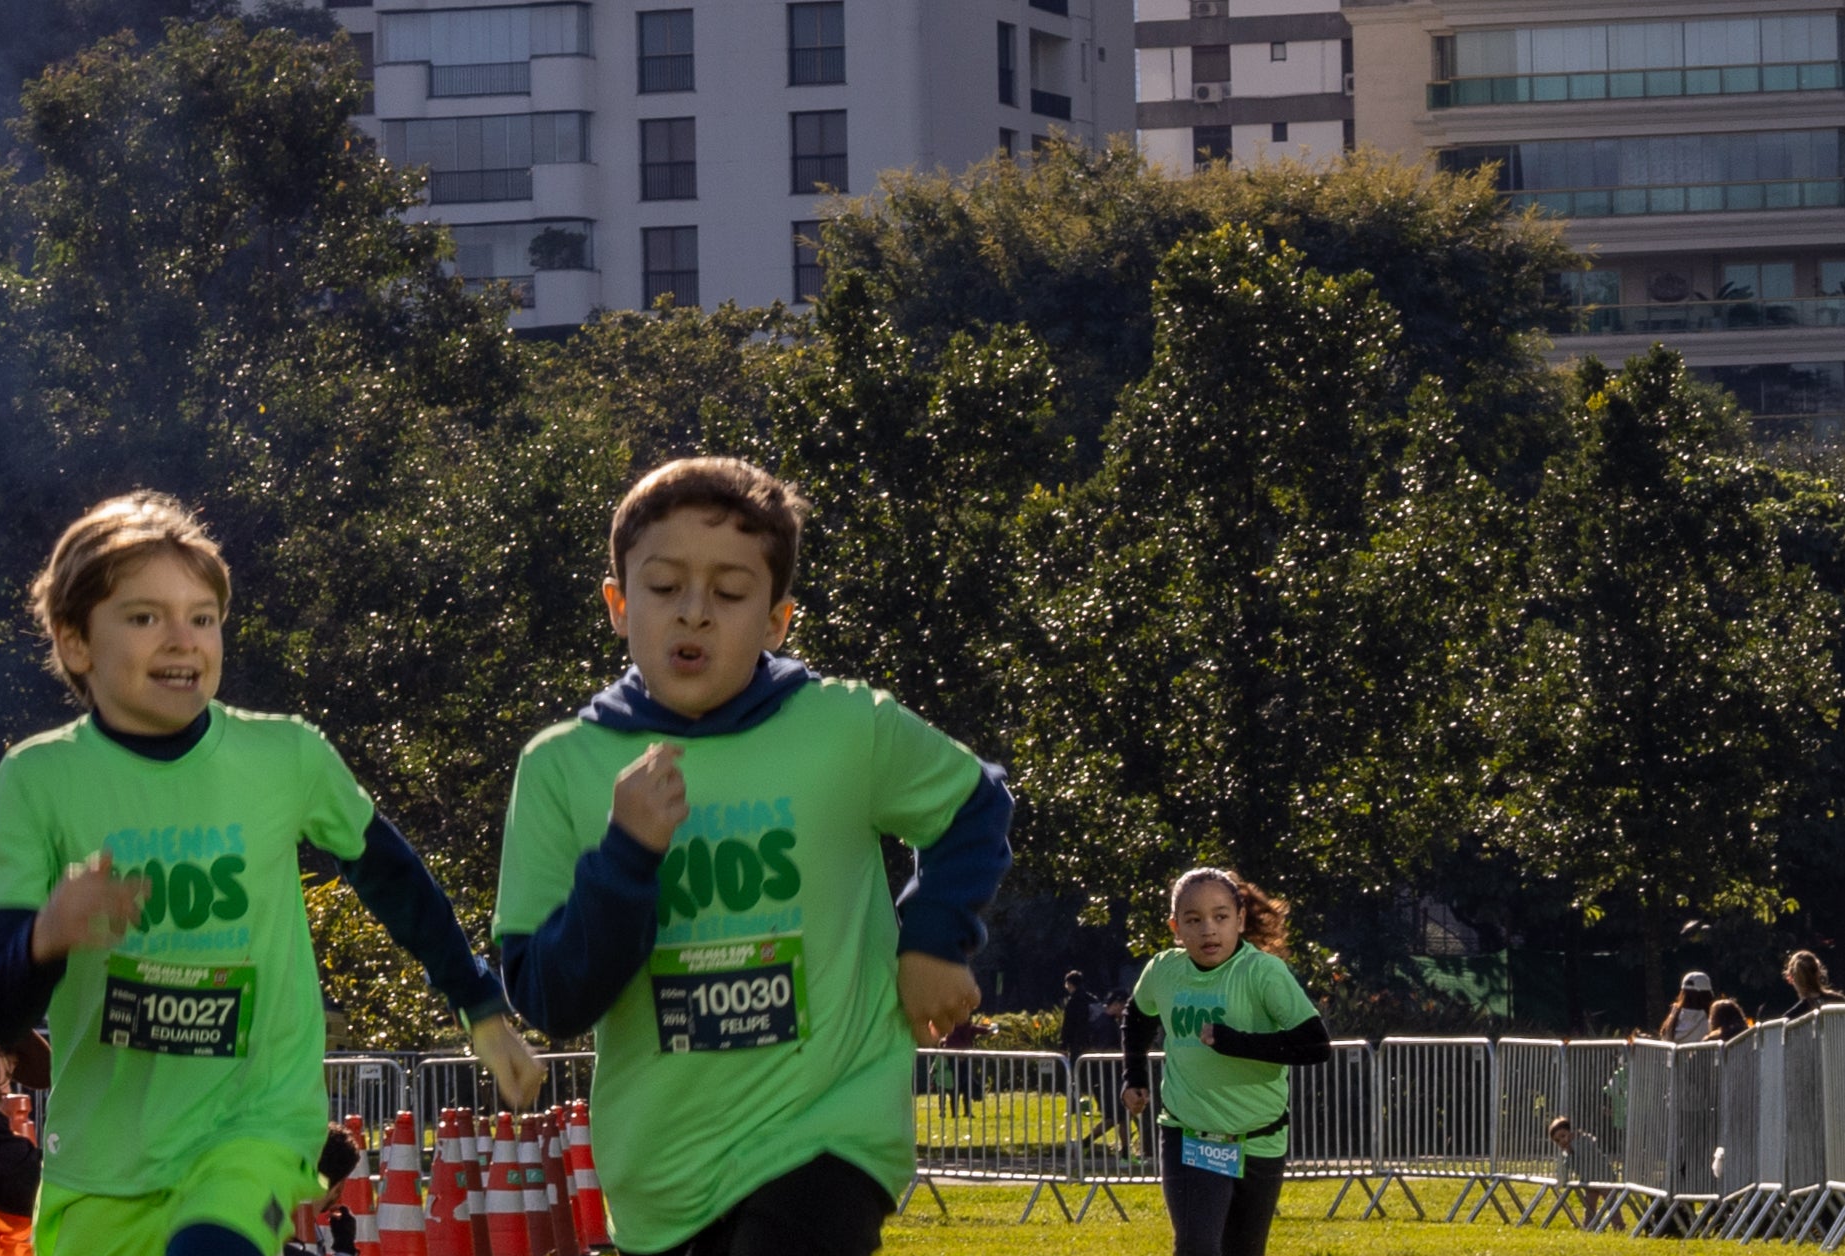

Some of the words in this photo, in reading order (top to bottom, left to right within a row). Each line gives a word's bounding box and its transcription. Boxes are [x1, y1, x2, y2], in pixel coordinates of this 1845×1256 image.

[658, 828, 801, 928] KIDS
[142, 992, 236, 1027] 10027
[691, 973, 792, 1017] 10030
[150, 1025, 221, 1044] EDUARDO
[720, 1013, 772, 1036] FELIPE
[1198, 1144, 1238, 1162] 10054
